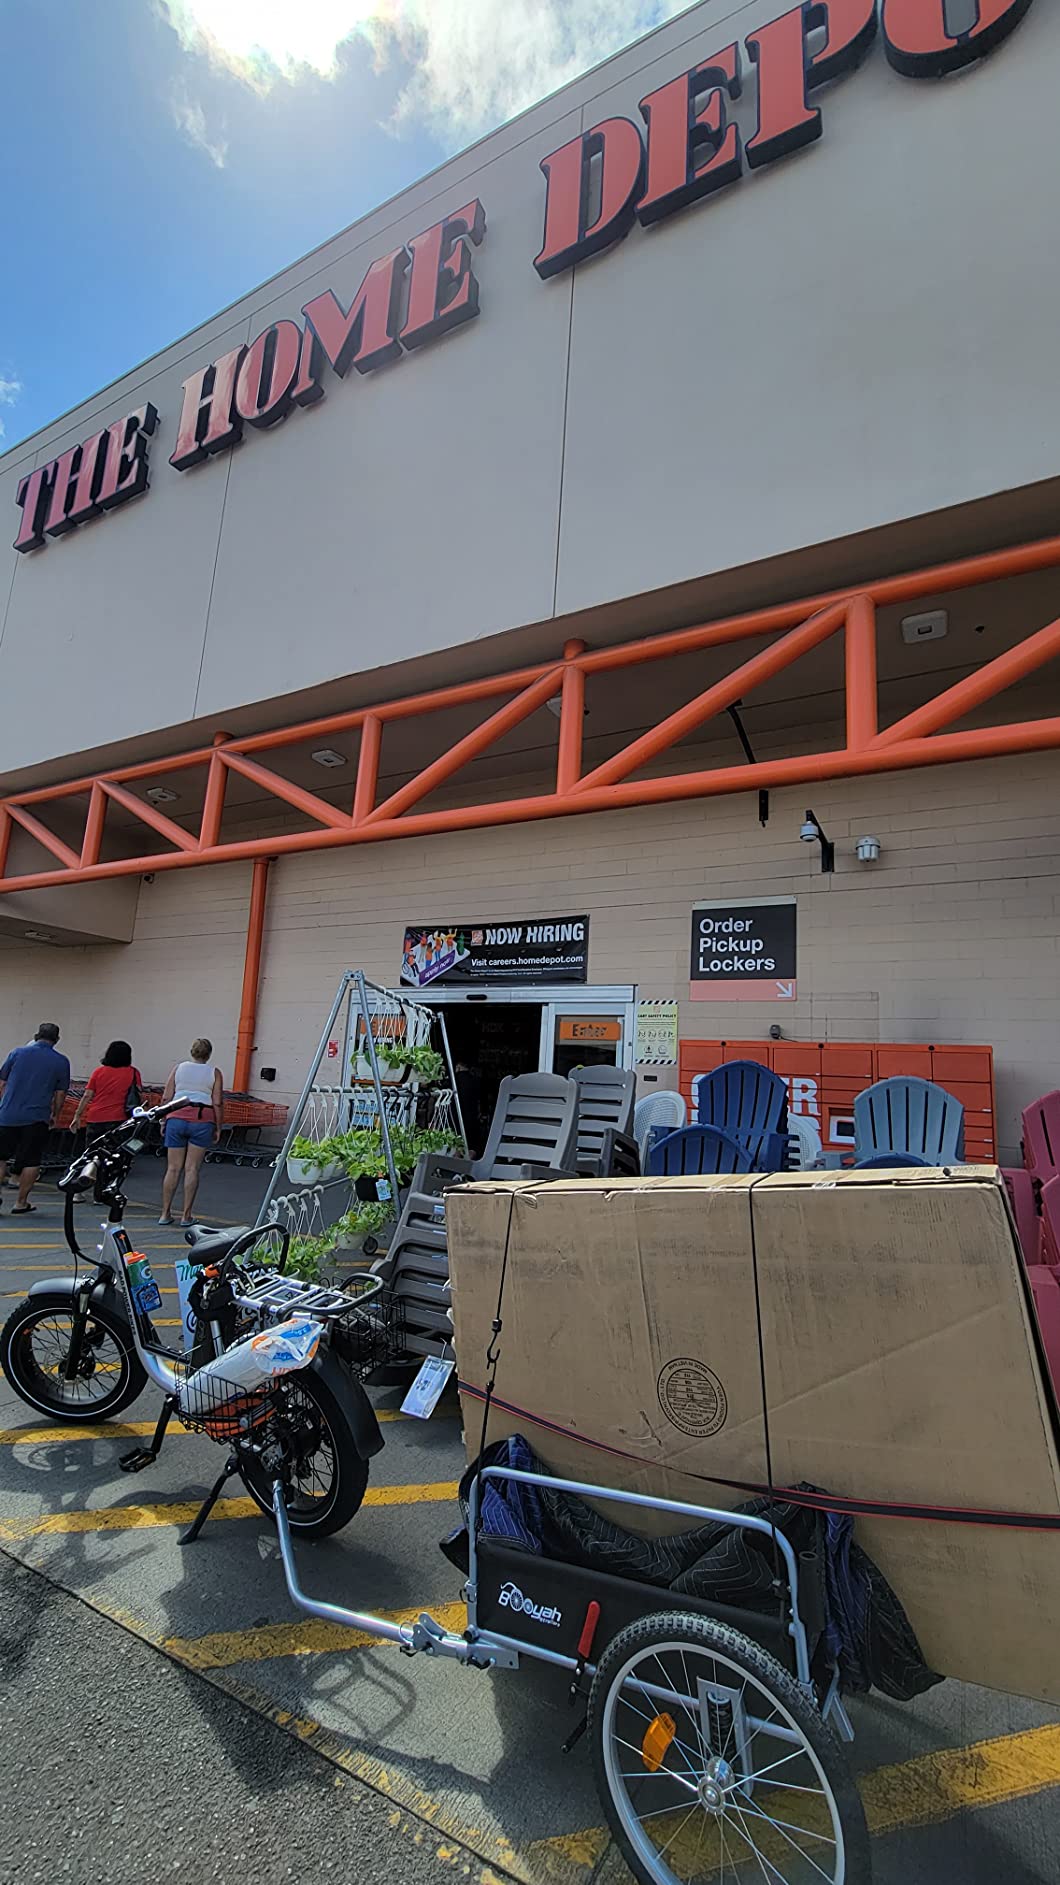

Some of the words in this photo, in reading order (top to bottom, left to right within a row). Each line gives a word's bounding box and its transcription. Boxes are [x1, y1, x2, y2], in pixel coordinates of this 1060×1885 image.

[13, 402, 157, 553] THE
[169, 197, 486, 471] HOME
[485, 926, 522, 945] NOW
[525, 922, 585, 943] HIRING
[699, 917, 753, 934] Order
[699, 936, 764, 954] Pickup
[471, 957, 487, 967] Visit
[488, 955, 584, 967] careers.homedepot.com
[698, 955, 776, 972] Lockers
[498, 1583, 562, 1622] Booyah
